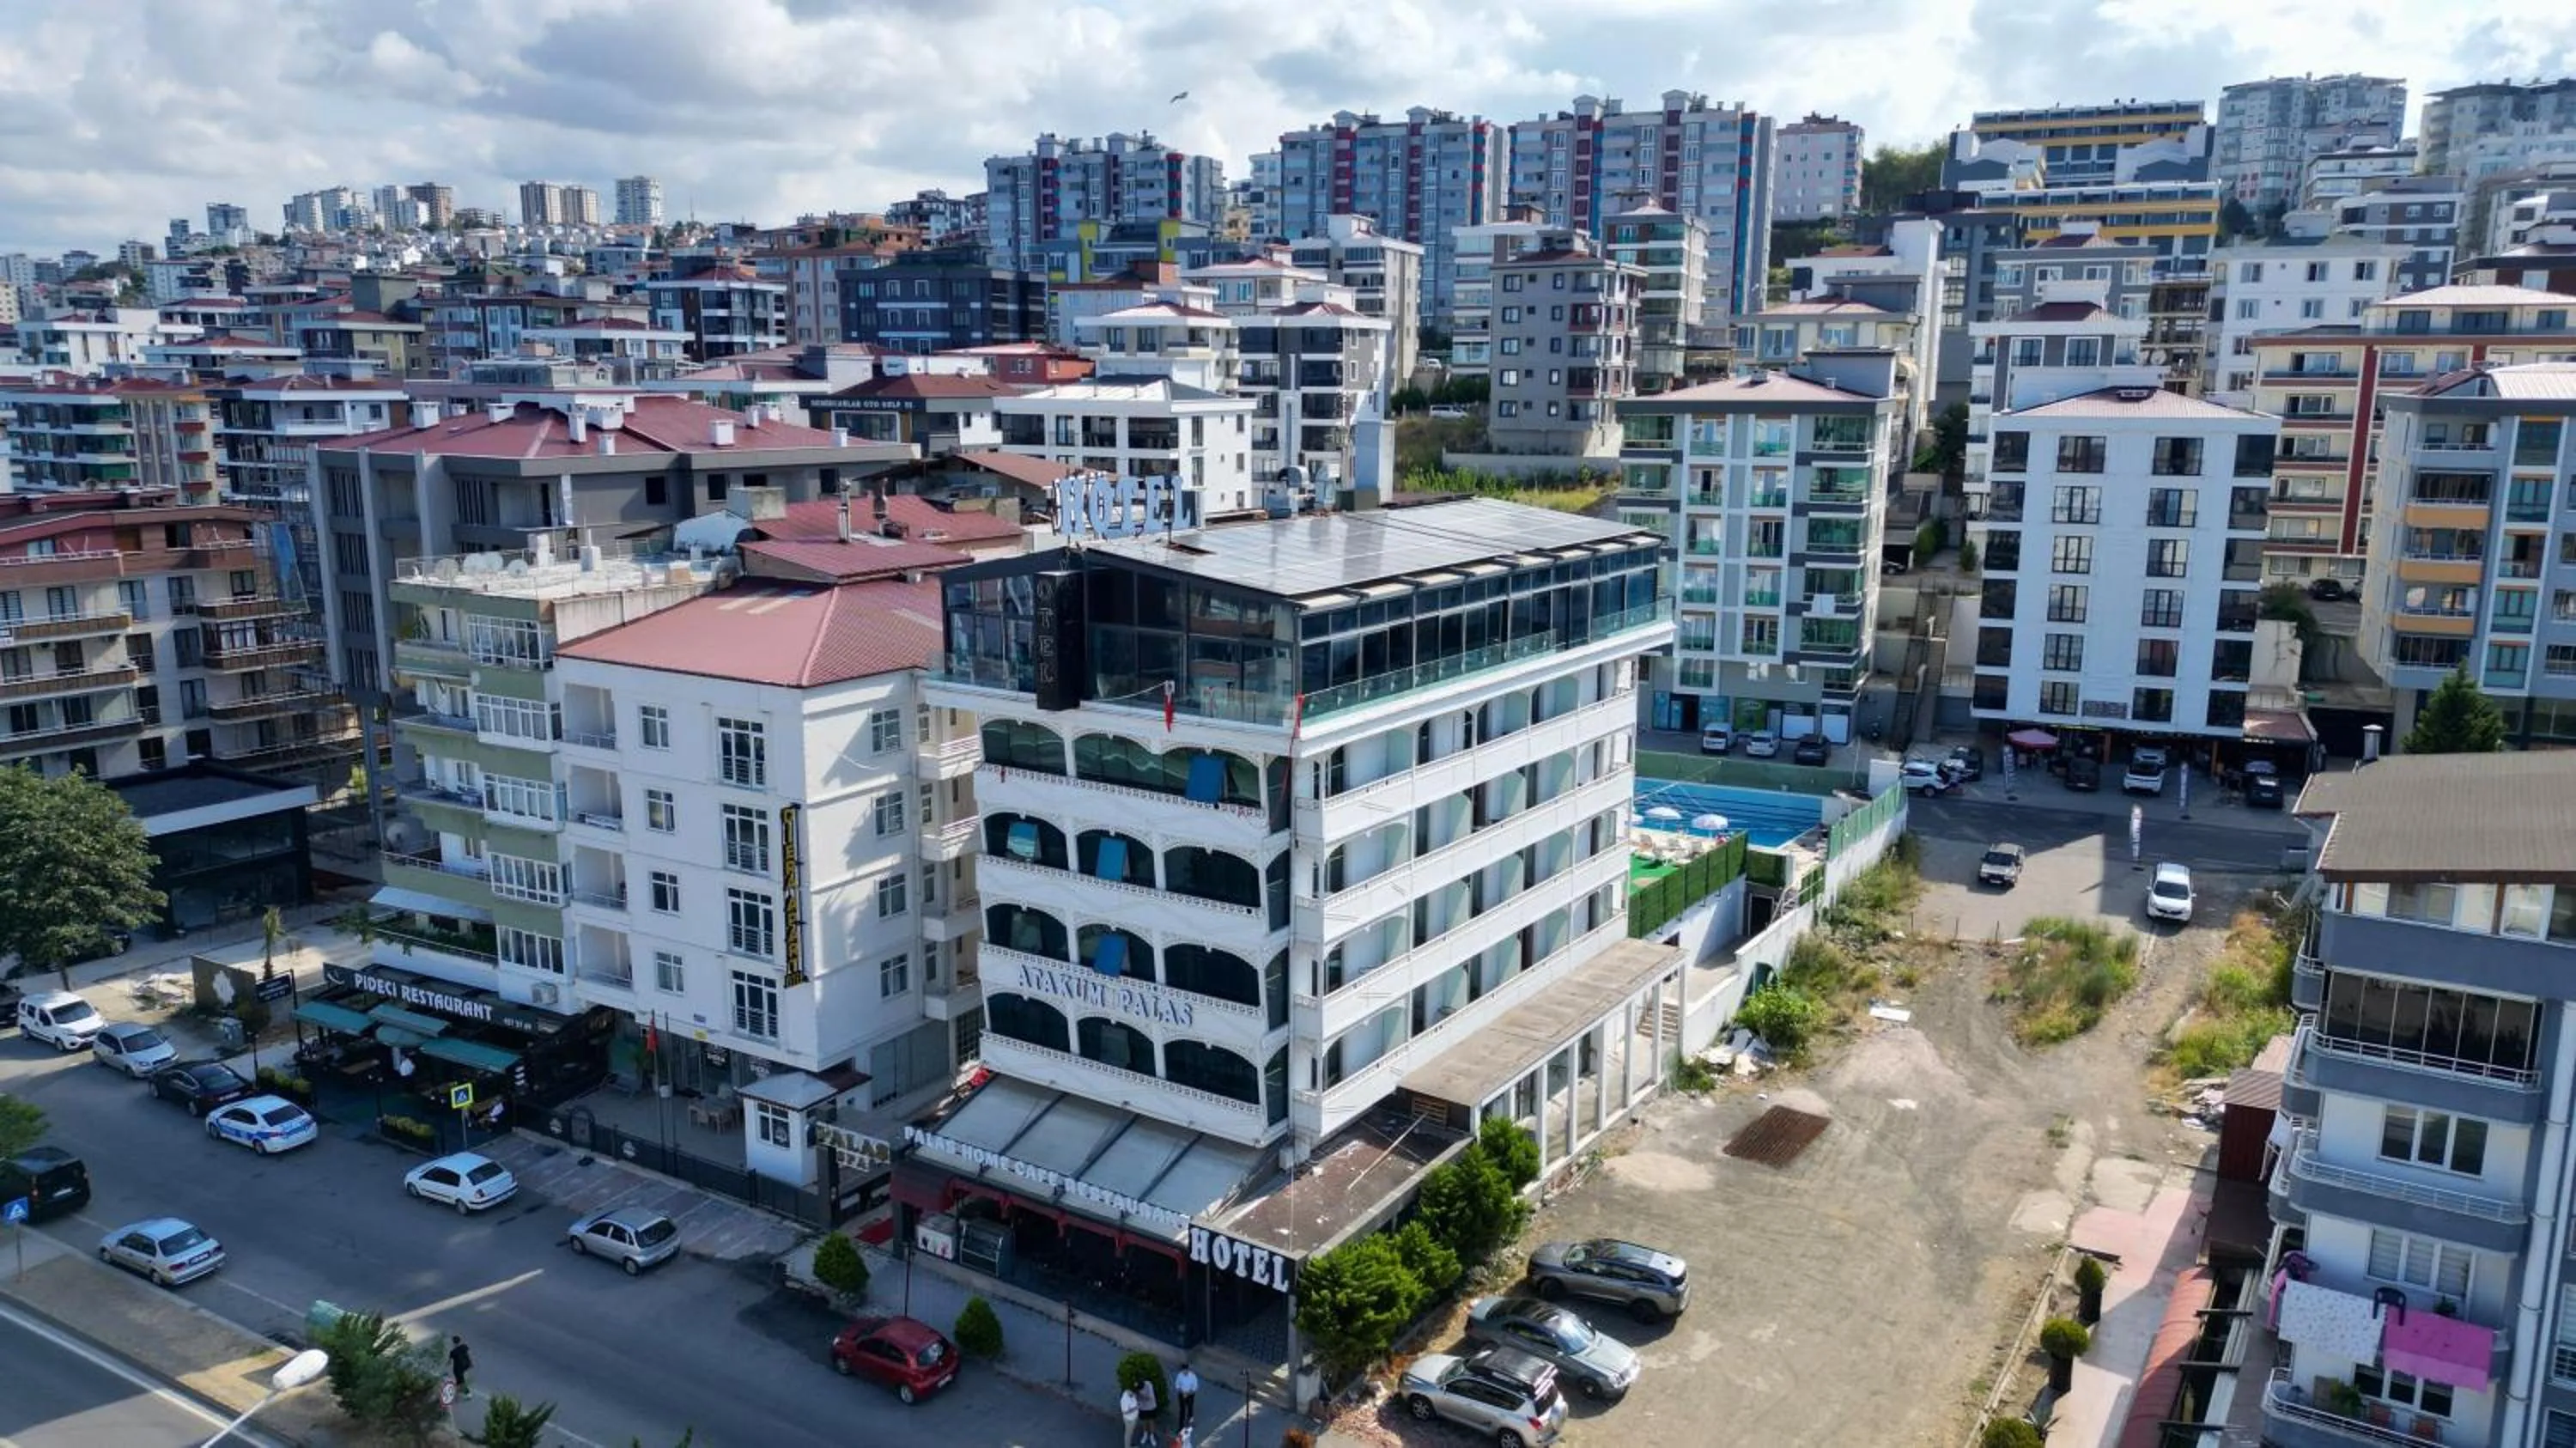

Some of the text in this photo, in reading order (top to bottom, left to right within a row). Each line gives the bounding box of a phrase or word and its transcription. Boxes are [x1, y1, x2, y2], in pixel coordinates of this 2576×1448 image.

[1054, 473, 1191, 539] HOTEL
[401, 985, 494, 1021] RESTAURANT
[1019, 964, 1194, 1026] ATAKUM PALAS
[961, 1144, 1011, 1171] HOME
[1015, 1160, 1060, 1187] CAFE
[1189, 1227, 1289, 1293] HOTEL
